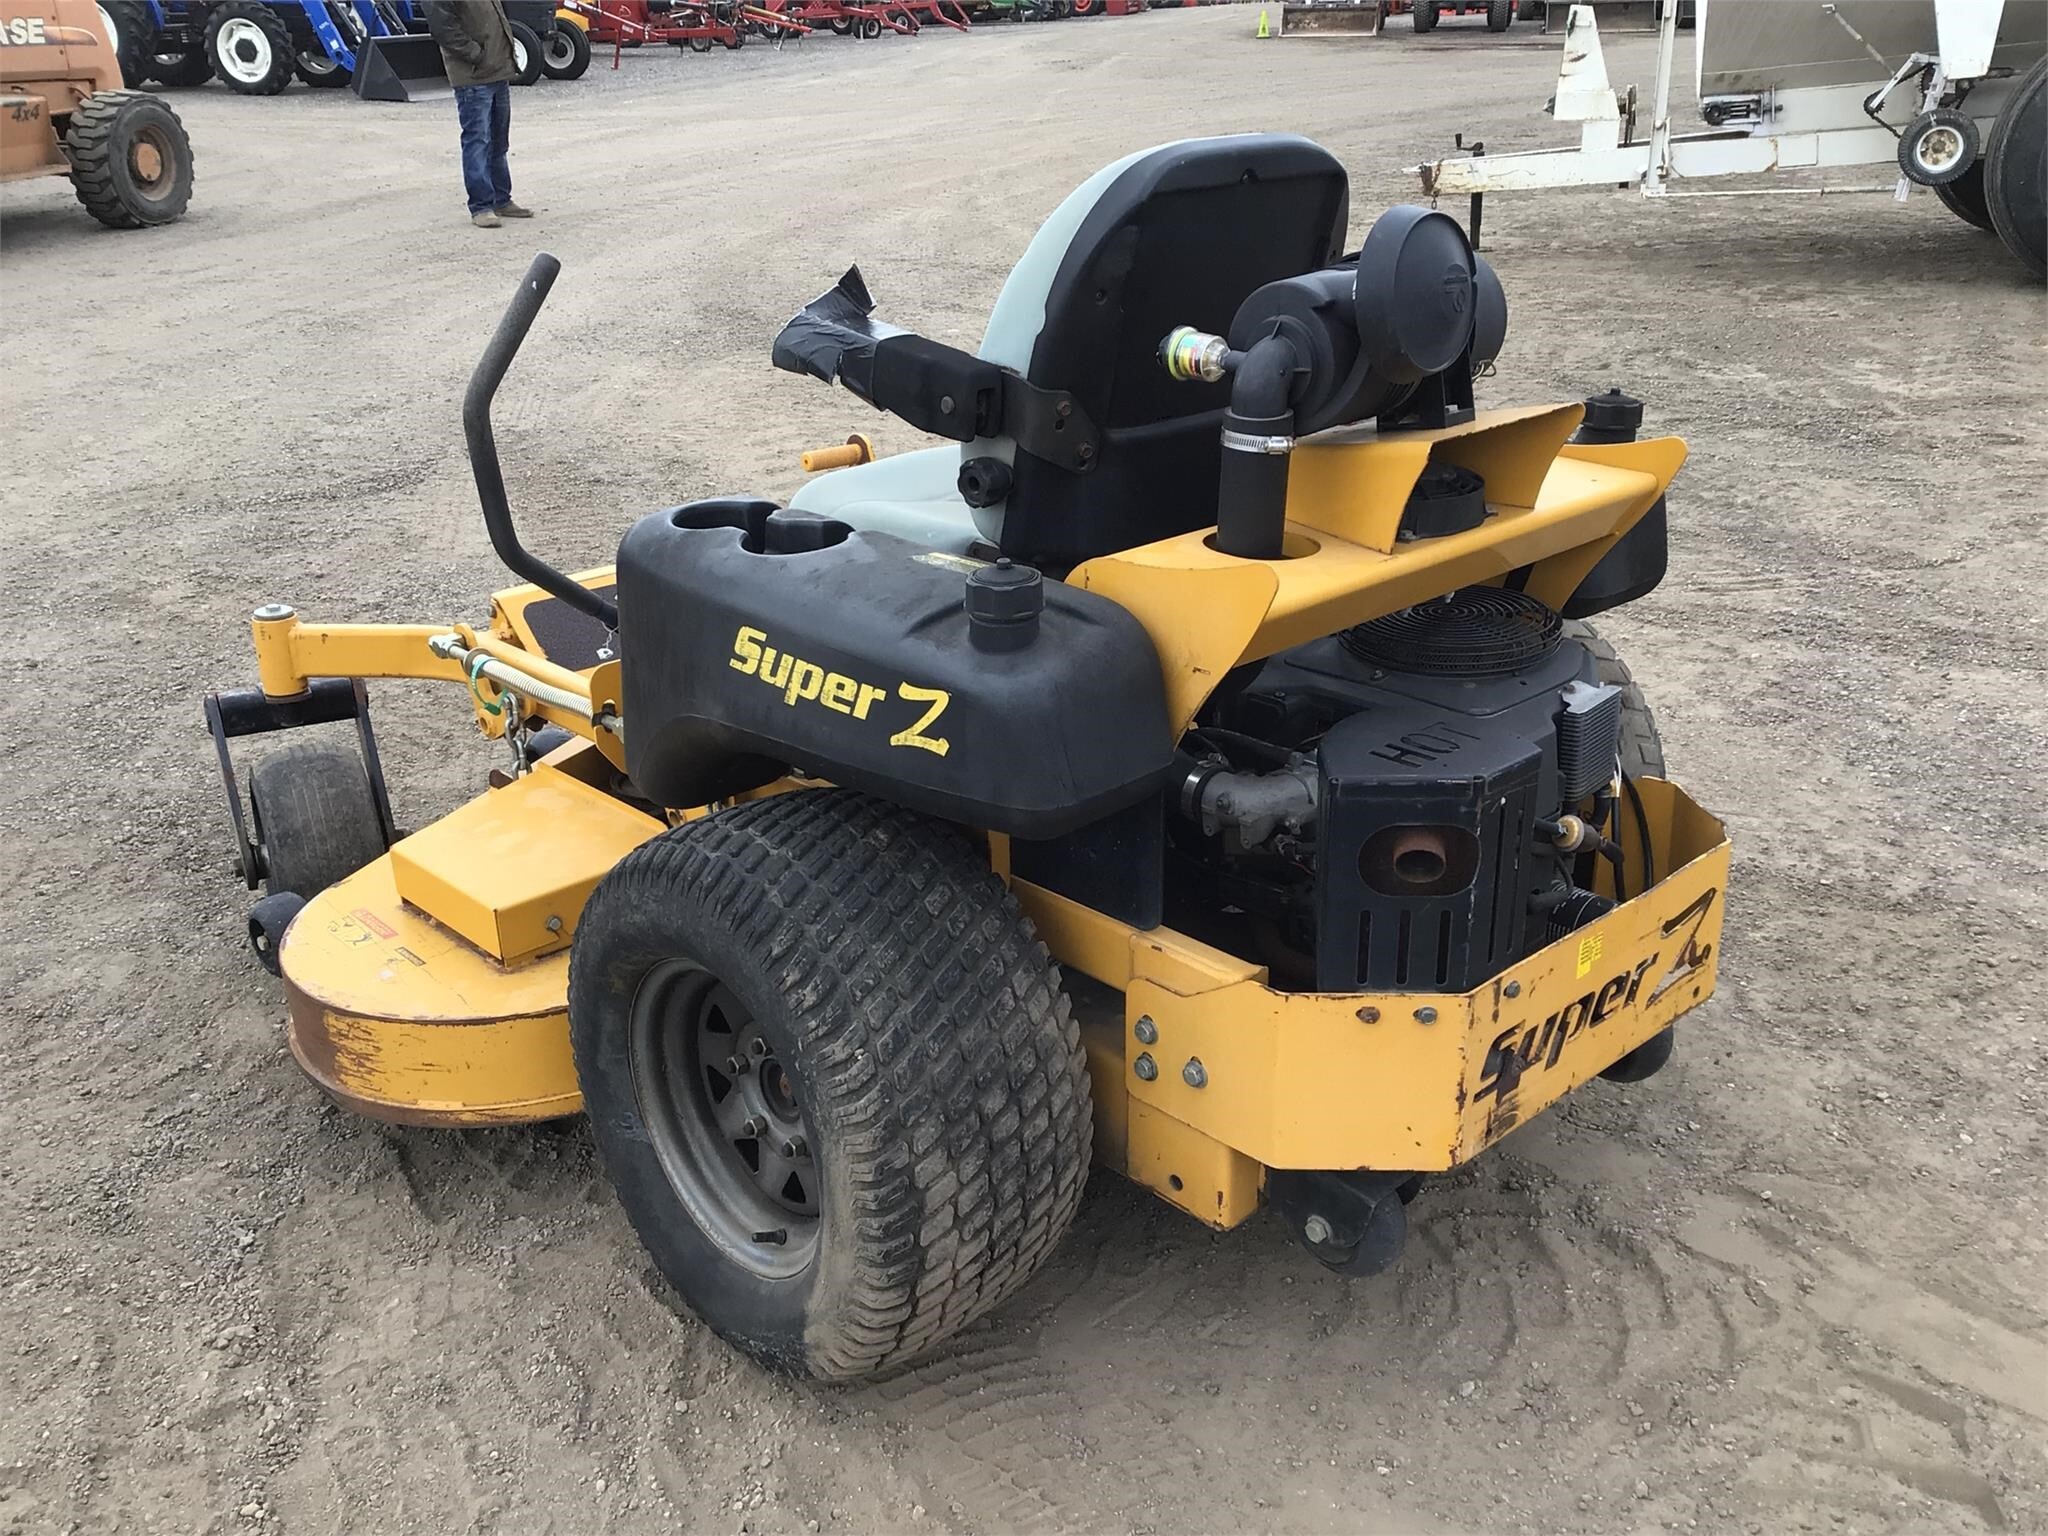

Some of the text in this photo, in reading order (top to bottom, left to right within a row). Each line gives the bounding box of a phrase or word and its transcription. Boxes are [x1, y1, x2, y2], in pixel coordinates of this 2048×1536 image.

[729, 625, 951, 757] Super Z
[1368, 721, 1481, 769] HOT
[1472, 887, 1717, 1104] Super Z
